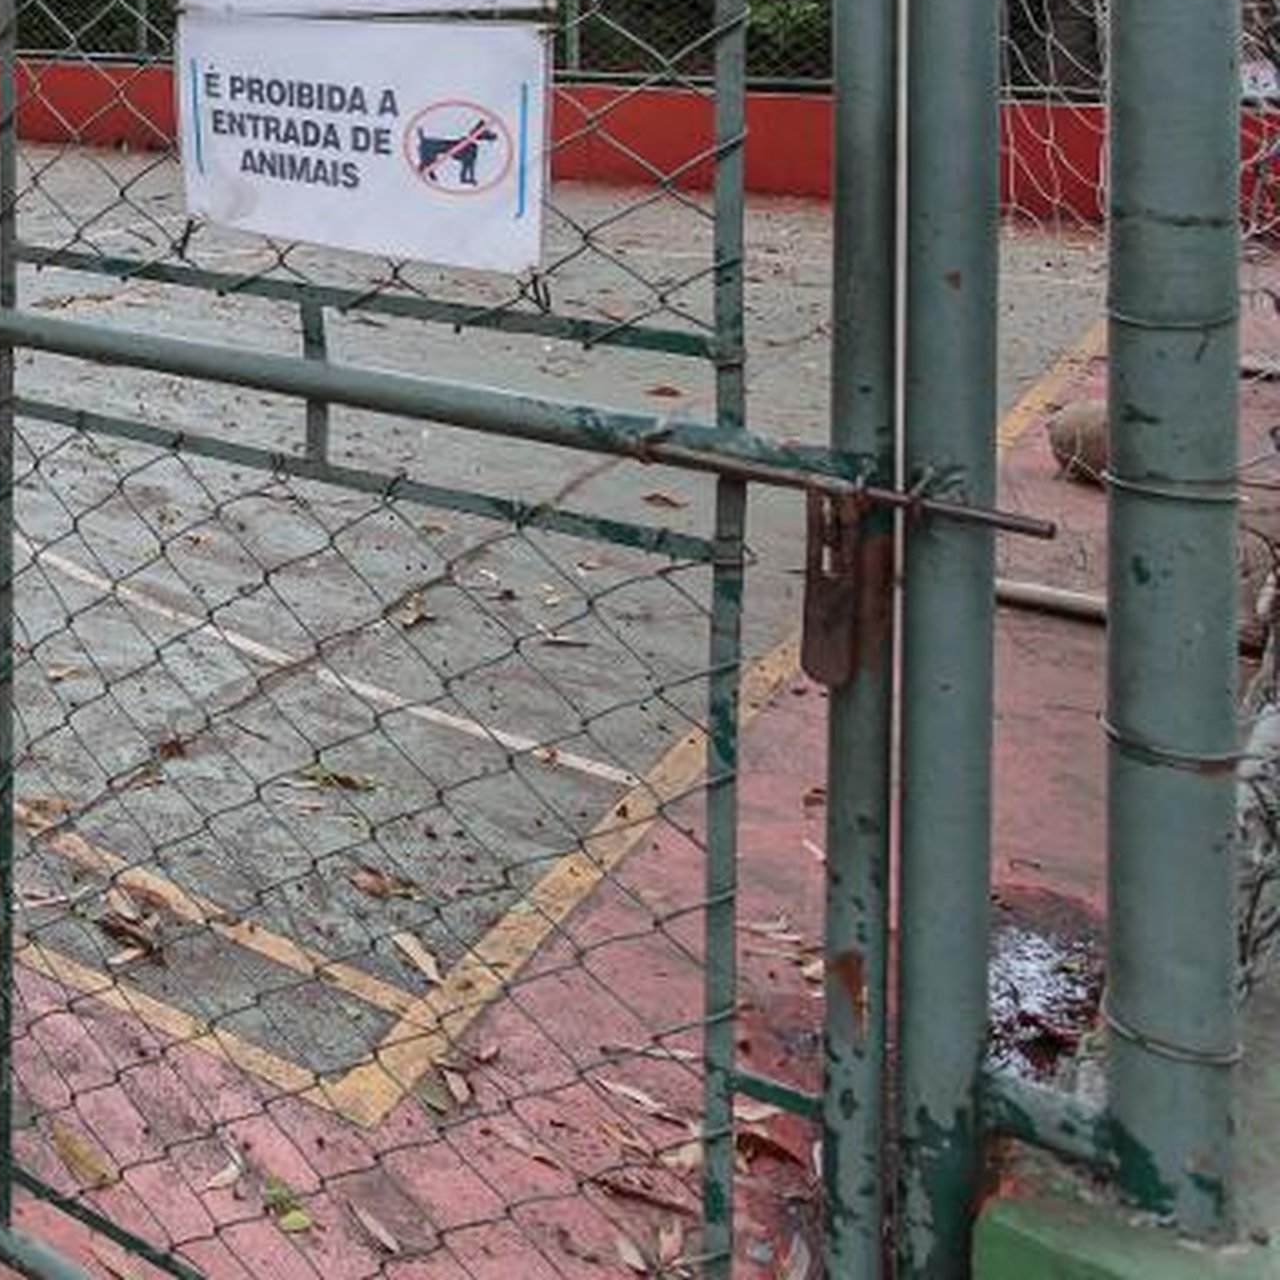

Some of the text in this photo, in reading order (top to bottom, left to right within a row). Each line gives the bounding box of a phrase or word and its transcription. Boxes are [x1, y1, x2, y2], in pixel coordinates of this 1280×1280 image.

[204, 65, 399, 118] É PROIBIDA A
[212, 108, 392, 156] ENTRADA DE
[240, 149, 360, 189] ANIMAIS
